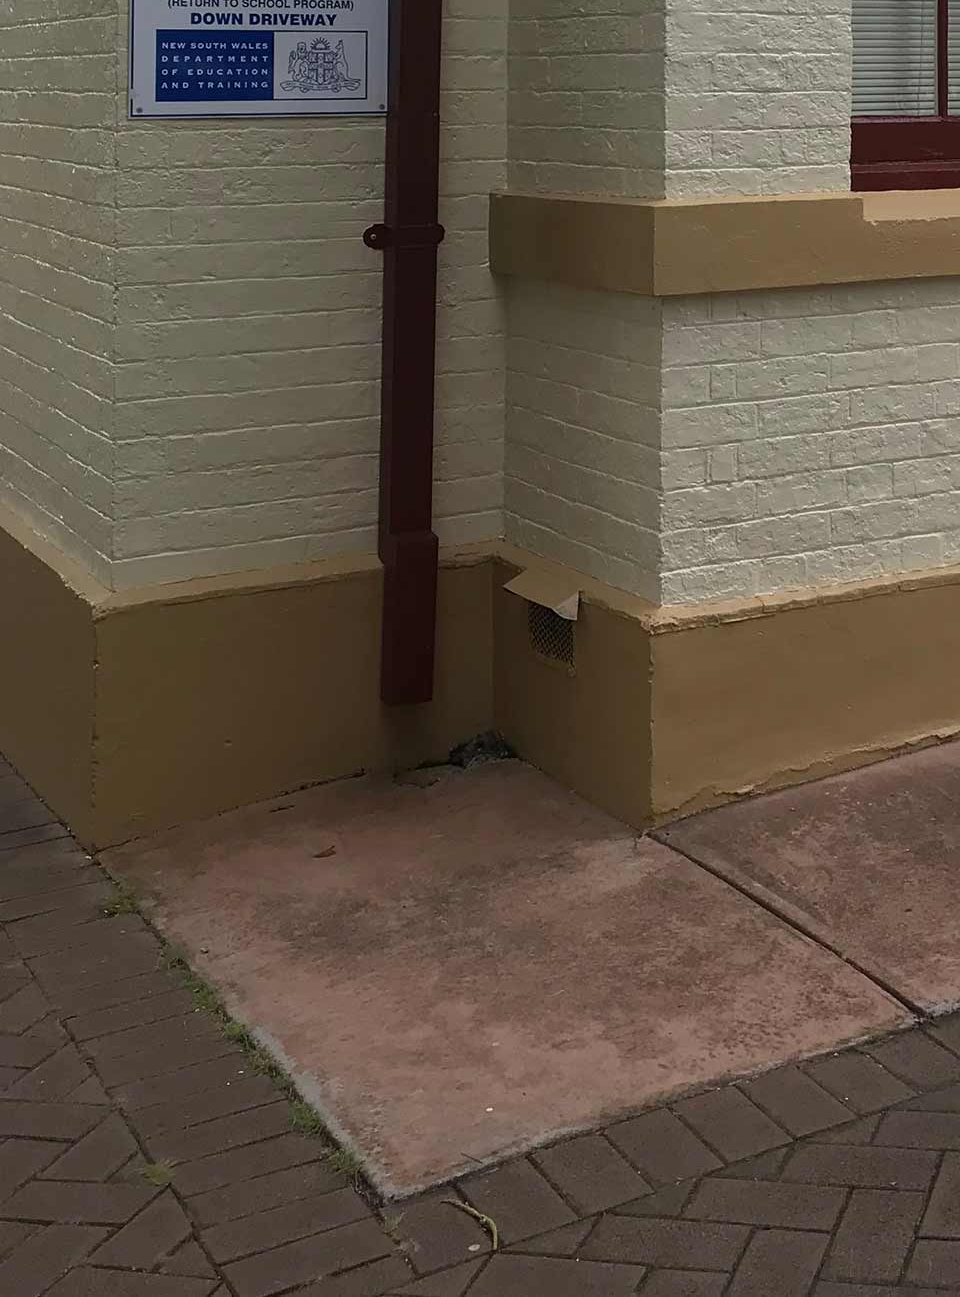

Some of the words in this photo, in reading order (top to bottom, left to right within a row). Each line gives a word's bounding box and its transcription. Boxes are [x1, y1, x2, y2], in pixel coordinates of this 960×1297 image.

[293, 0, 354, 11] PROGRAM)
[190, 12, 243, 25] DOWN
[249, 13, 337, 27] DRIVEWAY
[161, 42, 186, 50] NEW
[190, 42, 227, 50] SOUTH
[231, 42, 269, 50] WALES
[161, 55, 269, 63] DEPARTMENT
[161, 68, 179, 76] OF
[187, 68, 269, 76] EDUCATION
[161, 81, 190, 89] AND
[198, 81, 269, 89] TRAINING
